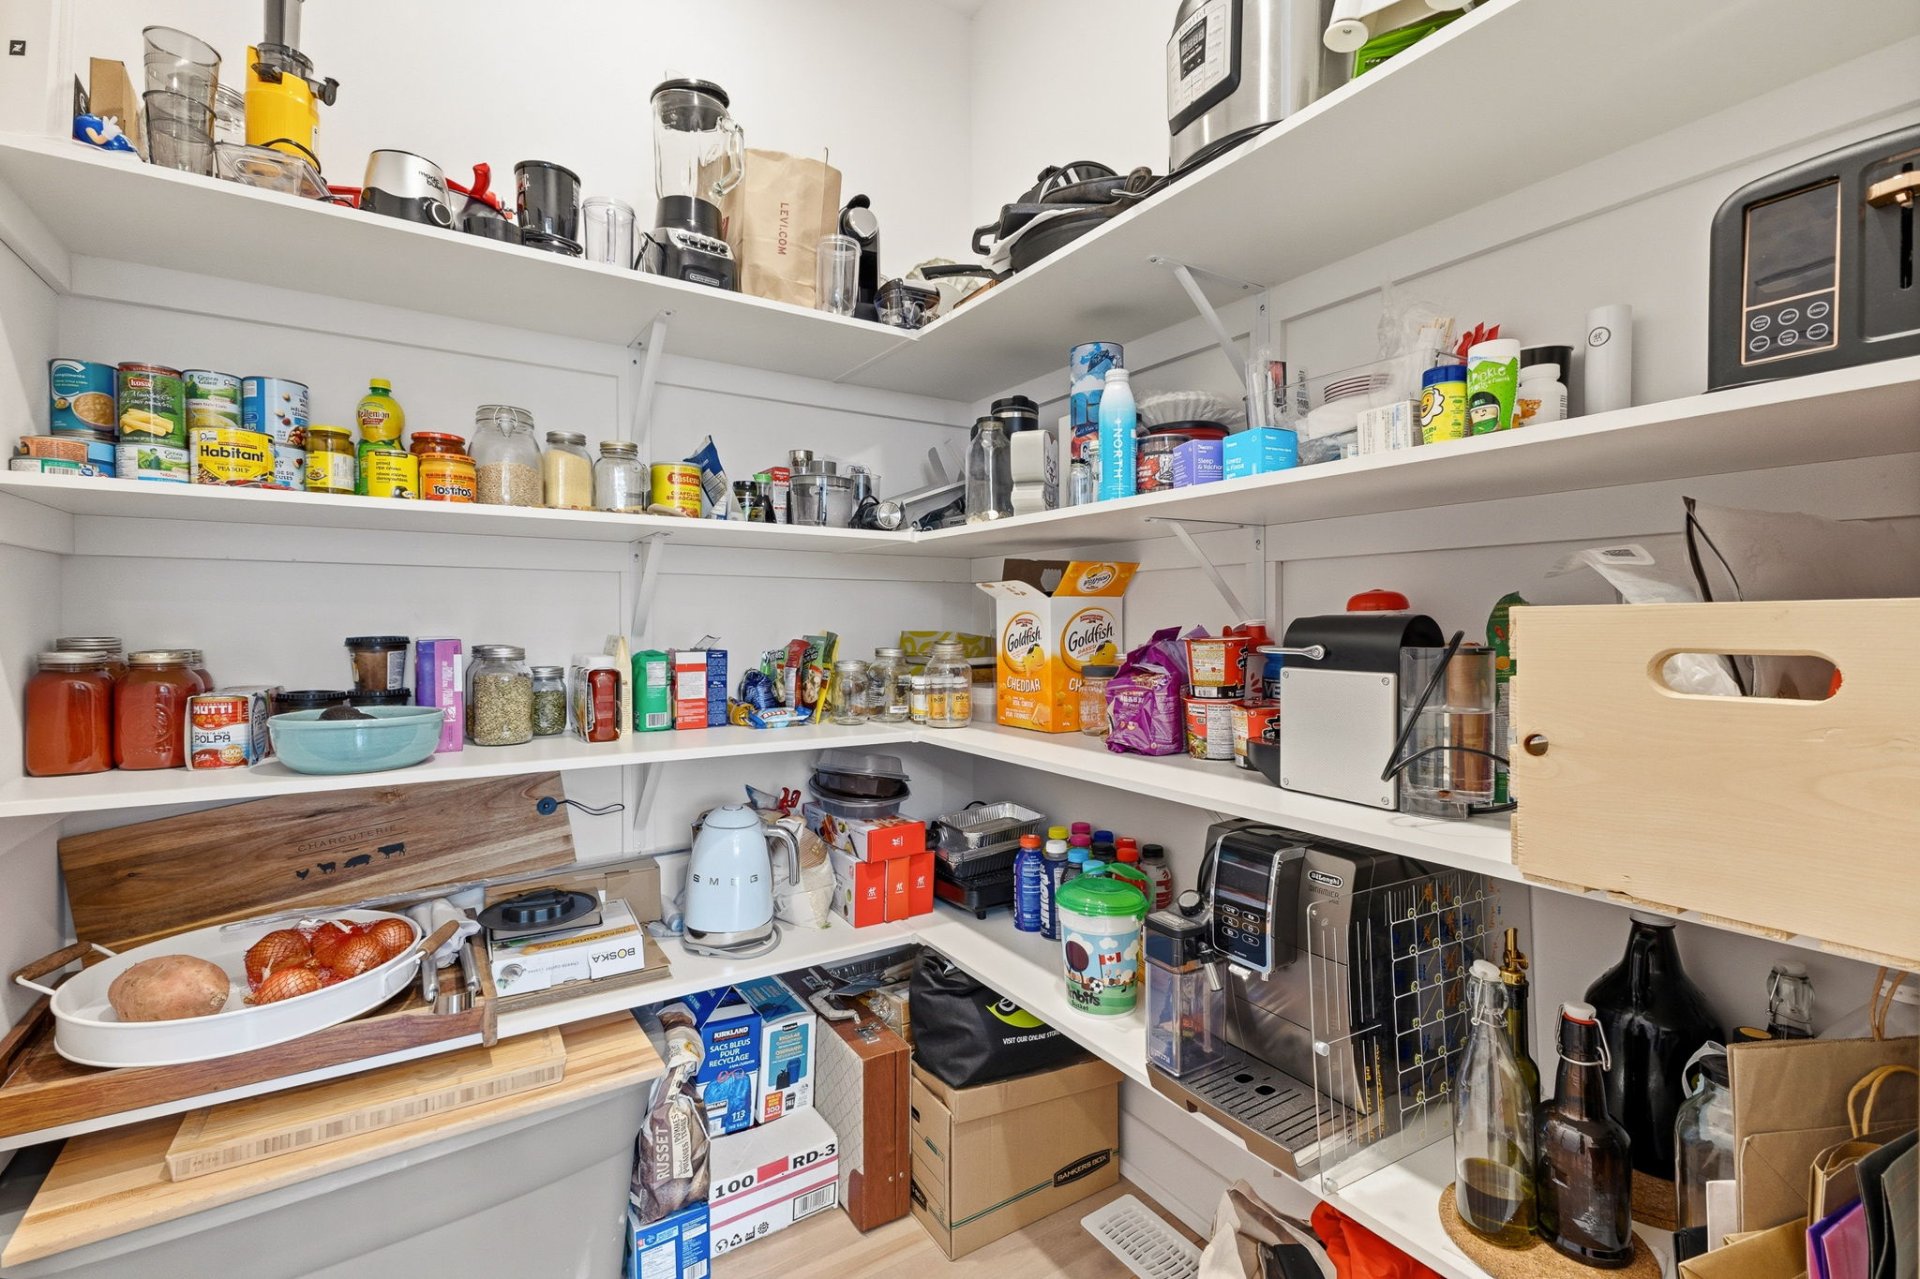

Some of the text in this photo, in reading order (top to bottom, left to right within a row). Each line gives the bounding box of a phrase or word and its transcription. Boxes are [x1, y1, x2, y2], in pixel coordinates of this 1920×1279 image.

[776, 202, 790, 255] LEVI.COM
[200, 444, 264, 463] Habitant
[1113, 428, 1123, 477] NORTH
[1008, 626, 1041, 652] Goldfish
[1069, 622, 1113, 652] Goldfish
[1006, 677, 1041, 692] CHEDDAR
[193, 704, 233, 715] MUTTI
[195, 734, 231, 743] POLPA
[297, 824, 397, 853] CHARCUTERIE
[592, 947, 636, 964] BOSKA
[713, 1027, 749, 1039] KIRKLAND
[1003, 1036, 1016, 1045] VISIT
[1016, 1035, 1028, 1043] OUR
[1028, 1033, 1046, 1041] ONLINE
[710, 1038, 751, 1053] SACS BLEUS
[720, 1049, 740, 1059] POUR
[709, 1053, 750, 1067] RECYCLAGE
[732, 1110, 746, 1122] 113
[656, 1126, 671, 1181] RUSSET
[681, 1142, 690, 1174] POTATOES
[793, 1144, 836, 1169] RD-3
[1057, 1154, 1108, 1182] BANKERS BOX
[715, 1176, 754, 1199] 100
